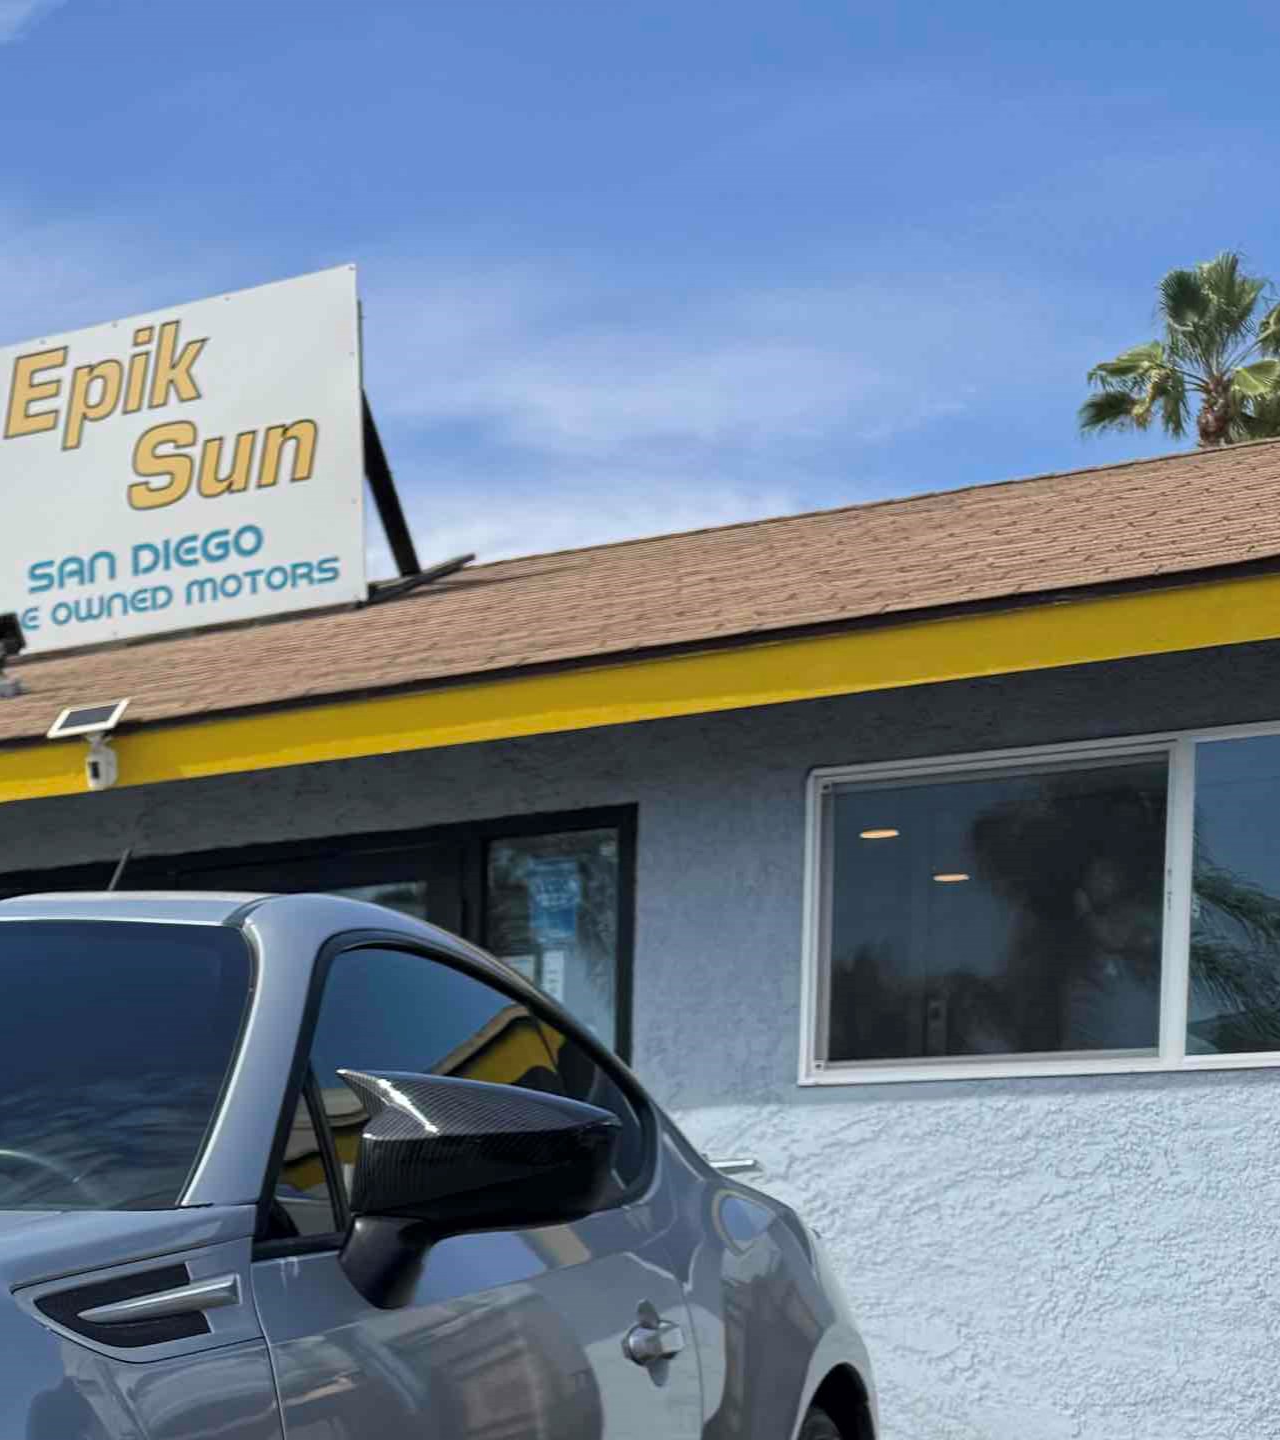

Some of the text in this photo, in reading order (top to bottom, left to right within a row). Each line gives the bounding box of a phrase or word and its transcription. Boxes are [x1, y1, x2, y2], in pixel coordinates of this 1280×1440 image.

[3, 319, 211, 452] Epik
[127, 418, 319, 511] Sun
[28, 524, 265, 595] SAN DIEGO
[50, 585, 174, 627] OWNED
[185, 556, 341, 606] MOTORS
